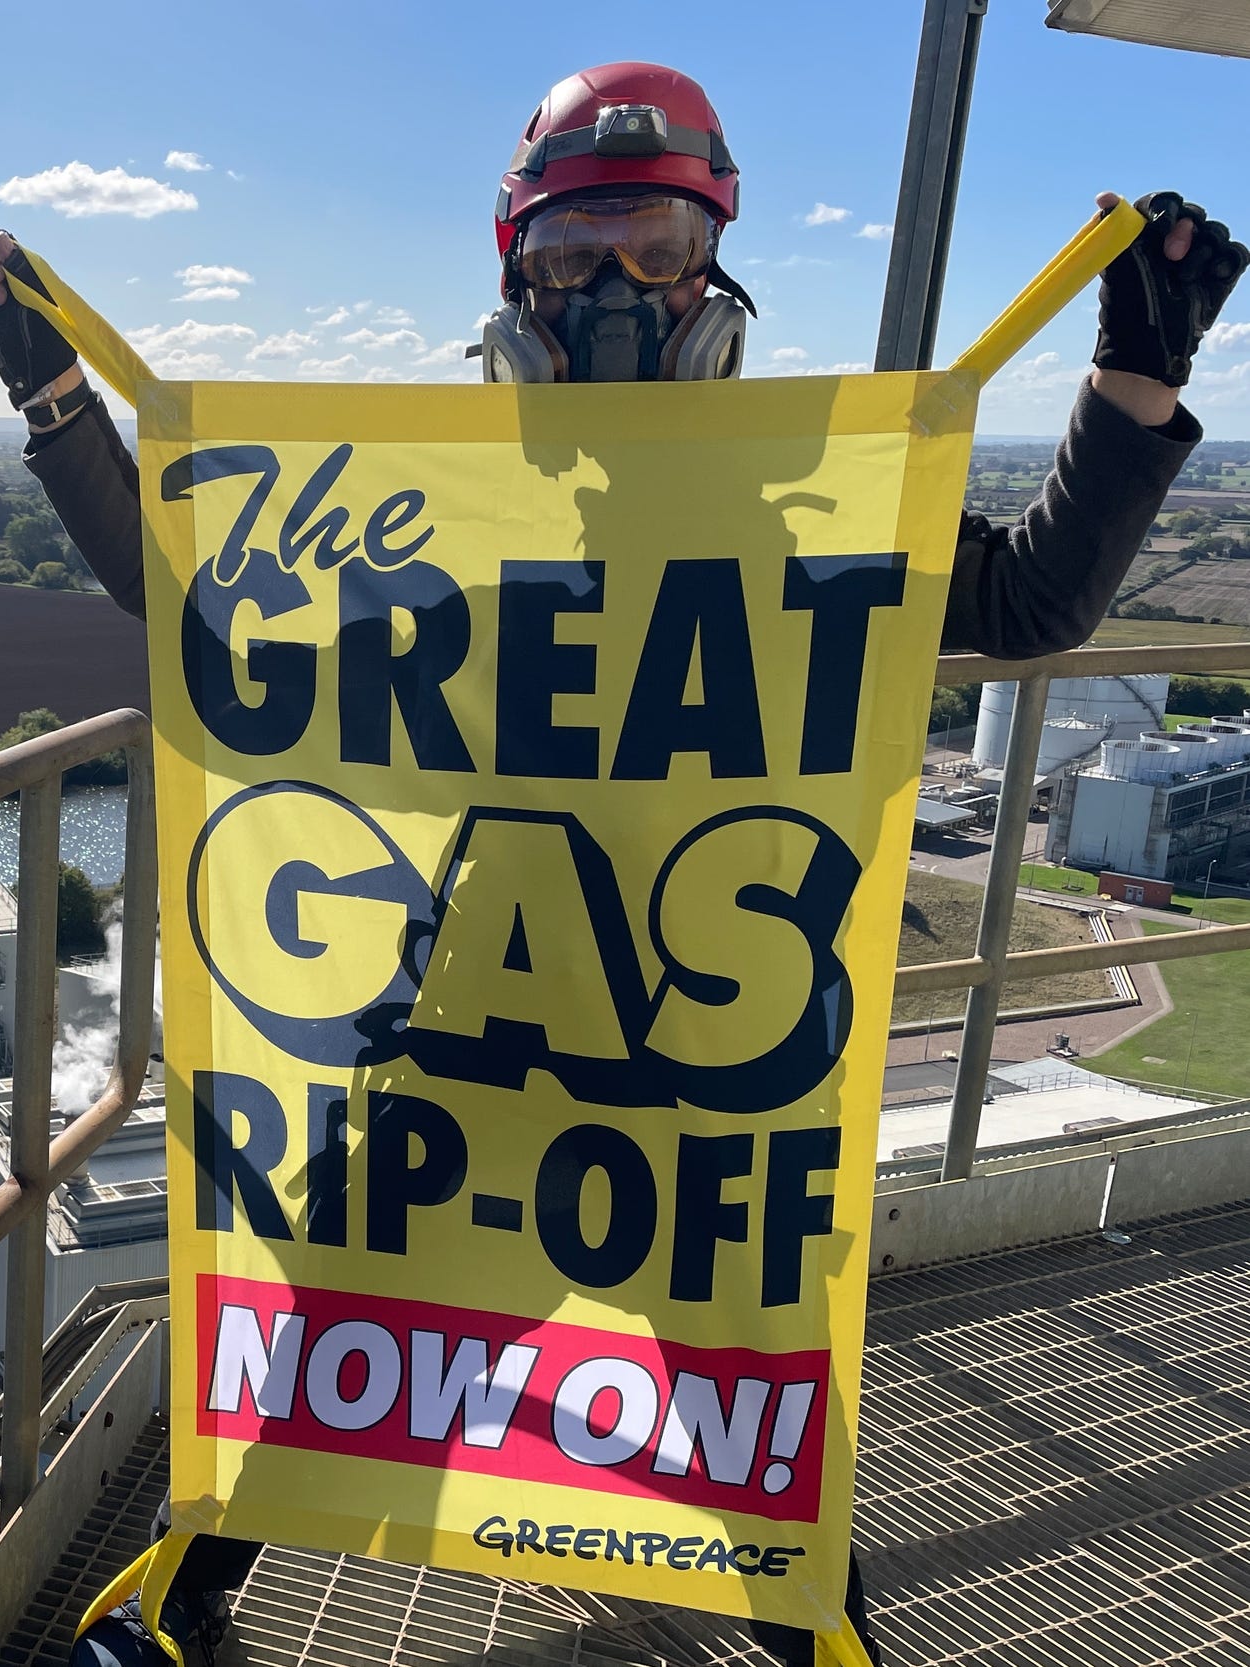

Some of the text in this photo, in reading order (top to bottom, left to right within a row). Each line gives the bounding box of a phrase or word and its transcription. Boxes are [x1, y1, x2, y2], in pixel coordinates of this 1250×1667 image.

[161, 443, 435, 584] The
[181, 548, 909, 781] GREAT
[186, 780, 864, 1114] GAS
[193, 1070, 843, 1309] RIP-OFF
[207, 1304, 819, 1498] NOW ON!
[473, 1515, 806, 1578] GREENPEACE
